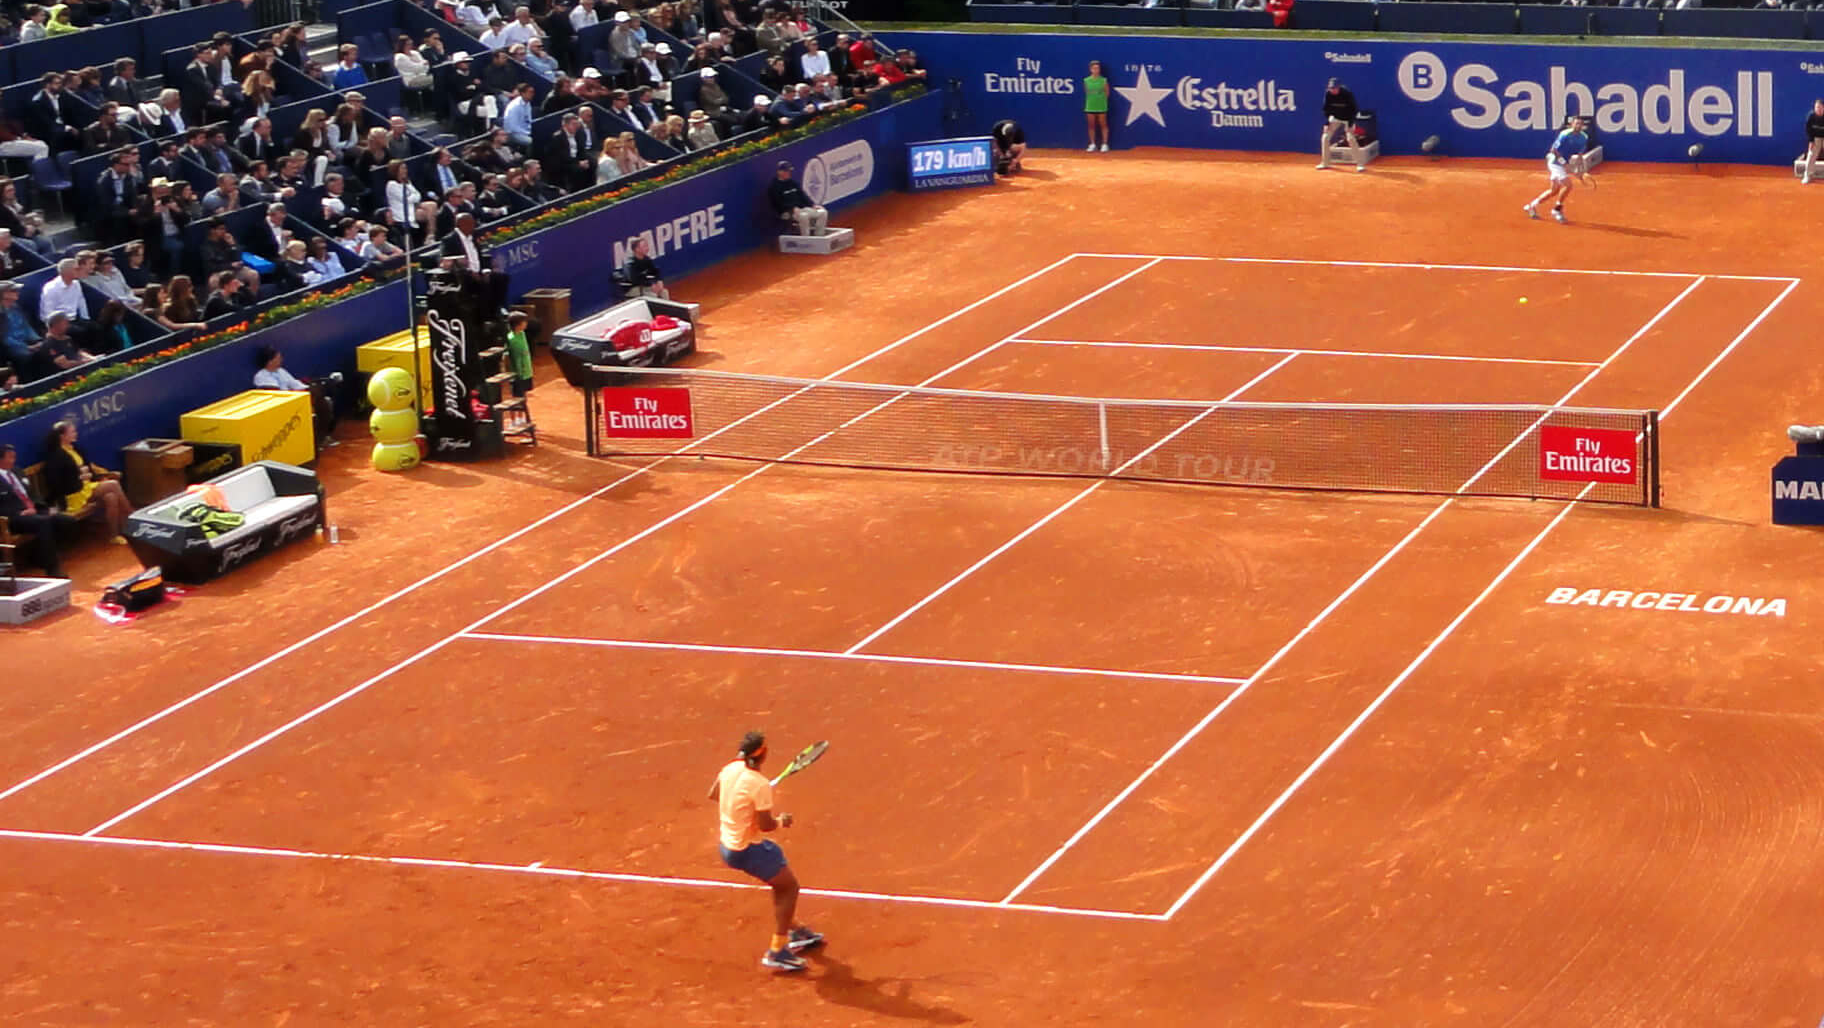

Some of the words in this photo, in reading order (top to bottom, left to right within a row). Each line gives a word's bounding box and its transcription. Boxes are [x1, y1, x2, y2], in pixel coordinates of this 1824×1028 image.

[1016, 57, 1041, 74] Fly
[984, 72, 1075, 95] Emirates
[1176, 76, 1297, 112] Estrella
[1451, 63, 1774, 137] Sabadell
[1210, 110, 1264, 128] Damm
[913, 150, 944, 172] 179
[948, 146, 987, 170] km/h
[613, 203, 725, 270] MAPFRE
[508, 239, 540, 267] MSC
[426, 308, 467, 420] Freixenet
[82, 390, 126, 424] MSC
[634, 397, 658, 412] Fly
[608, 411, 688, 429] Emirates
[1575, 437, 1600, 455] Fly
[1175, 453, 1276, 484] TOUR
[1545, 451, 1632, 474] Emirates
[1545, 586, 1788, 618] BARCELONA
